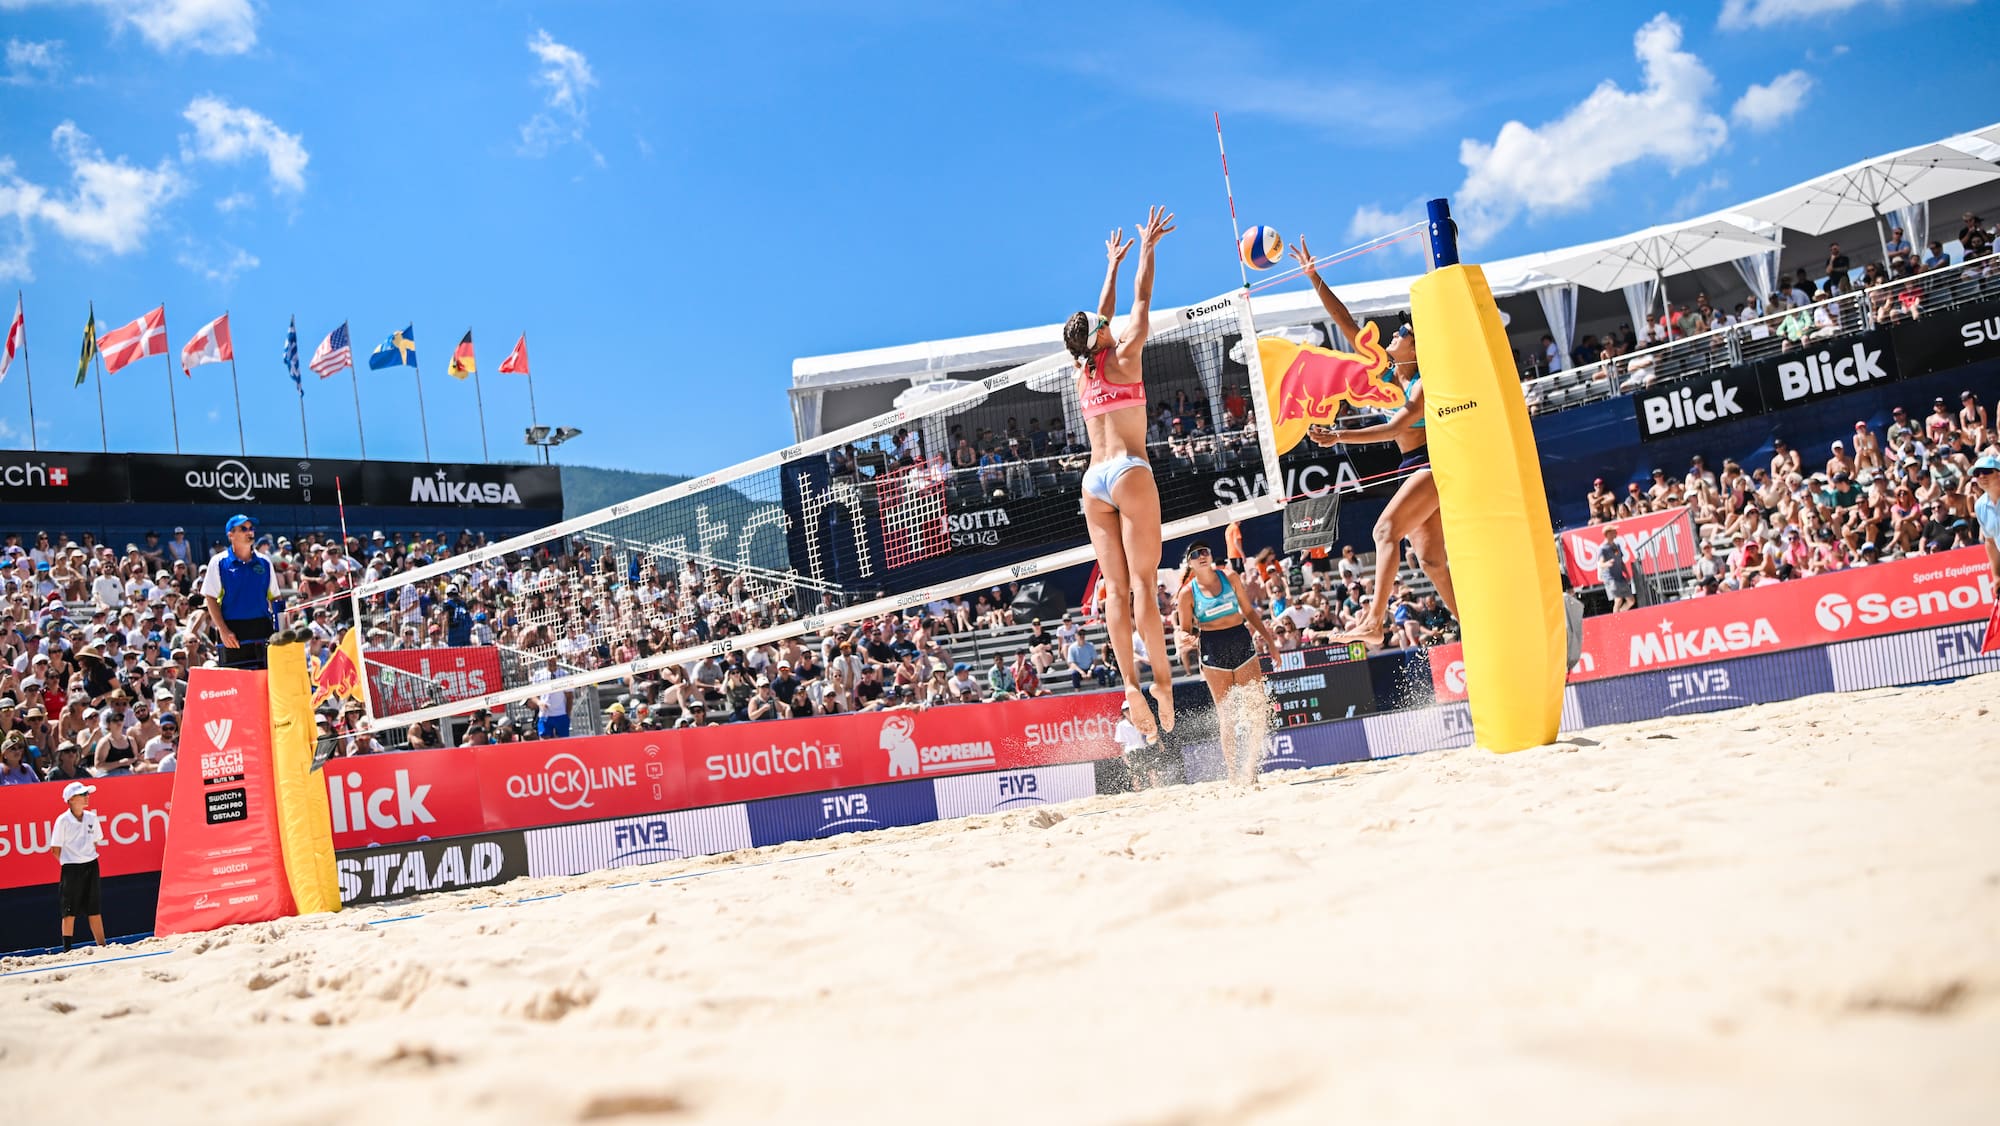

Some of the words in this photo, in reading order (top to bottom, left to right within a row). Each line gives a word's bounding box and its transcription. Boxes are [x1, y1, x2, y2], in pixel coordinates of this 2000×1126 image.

[1196, 299, 1231, 317] Senoh
[1777, 342, 1887, 401] Blick
[1090, 391, 1117, 405] VBTV
[1445, 400, 1477, 415] Senoh
[1643, 380, 1743, 435] Blick
[0, 462, 46, 486] ch
[1913, 567, 1943, 584] Sports
[1856, 574, 1995, 625] Senoh
[1936, 628, 1986, 659] FIV
[208, 687, 238, 699] Senoh
[1668, 668, 1730, 698] FIVB
[1024, 714, 1113, 748] swatch
[201, 753, 244, 769] BEACH
[706, 741, 823, 782] swatch
[921, 741, 995, 763] SOPREMA
[202, 767, 220, 778] PRO
[220, 764, 244, 775] TOUR
[999, 774, 1037, 796] FIVB
[208, 792, 237, 803] swatch
[209, 803, 229, 812] BEACH
[230, 801, 243, 809] PRO
[329, 769, 437, 833] lick
[822, 793, 868, 820] FIVB
[212, 811, 241, 821] GSTAAD
[615, 820, 669, 848] FIVB
[212, 862, 249, 875] swatch
[336, 842, 505, 903] STAAD
